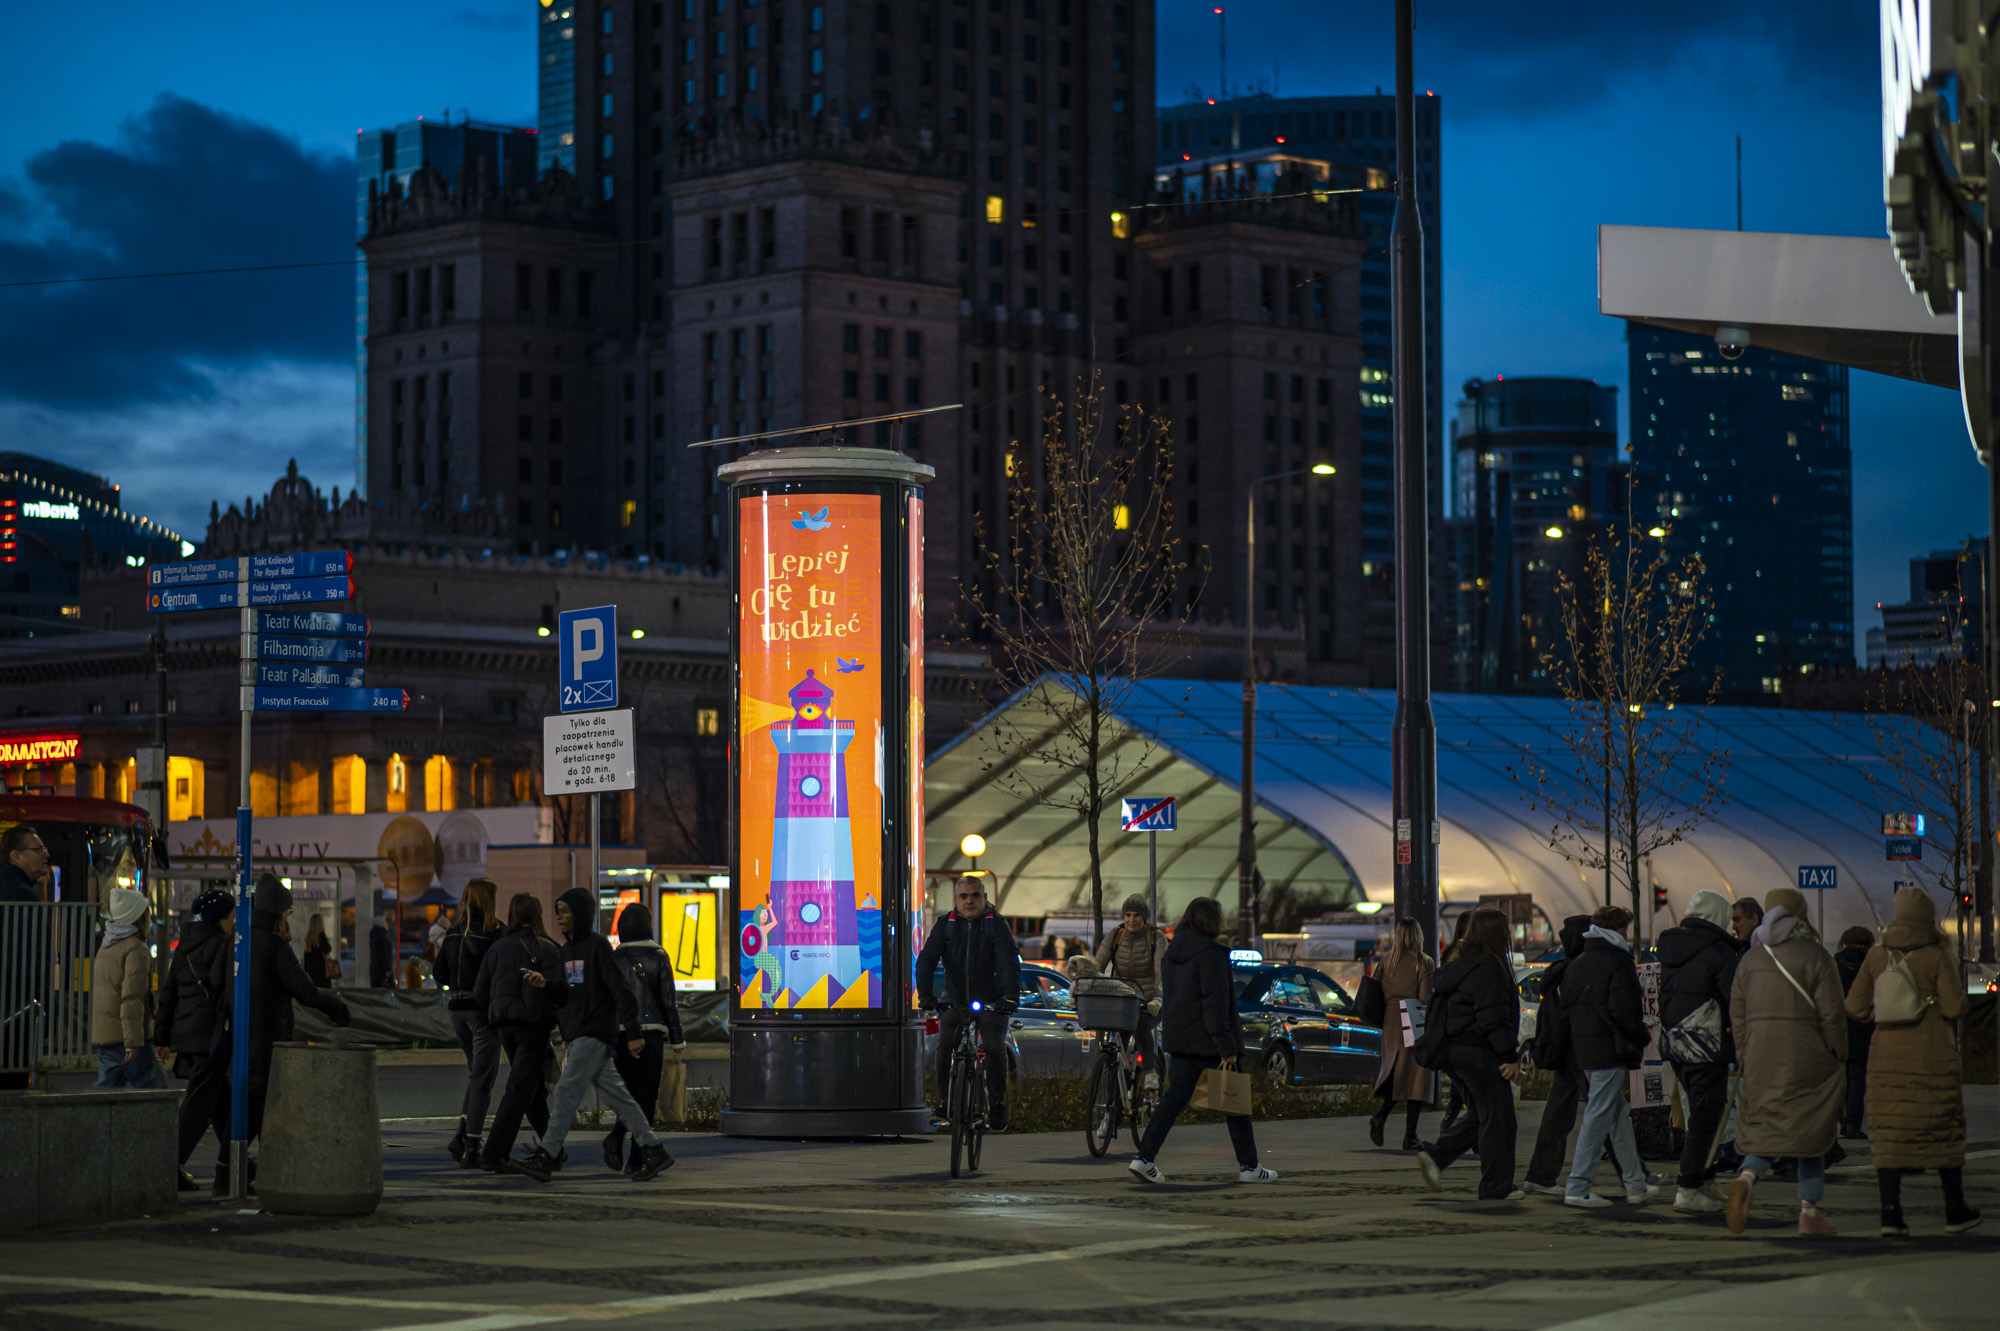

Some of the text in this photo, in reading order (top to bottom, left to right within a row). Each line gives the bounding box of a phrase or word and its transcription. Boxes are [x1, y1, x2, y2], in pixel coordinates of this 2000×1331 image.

[22, 500, 80, 520] mBank
[254, 555, 294, 566] Trakt Królewski
[768, 544, 849, 580] Lepiej
[163, 563, 216, 577] Informacja Turystyczna
[254, 566, 295, 578] The Royal Road
[326, 563, 337, 572] 650
[164, 573, 208, 583] Tourist Information
[218, 570, 229, 579] 670
[253, 582, 291, 594] Polska Agencja
[326, 589, 345, 598] 350 m
[162, 592, 197, 607] Centrum
[220, 594, 227, 603] 80
[253, 592, 278, 604] Inwestycji
[282, 591, 301, 601] Handlu
[751, 583, 836, 615] Cię tu
[265, 613, 337, 631] Teatr Kwadrat
[346, 622, 357, 632] 700
[760, 610, 861, 642] widzieć
[264, 640, 324, 657] Filharmonia
[345, 649, 356, 658] 550
[573, 617, 604, 680] P
[261, 667, 339, 684] Teatr Palladium
[262, 696, 330, 708] Instytut Francuski
[373, 697, 389, 706] 240
[564, 686, 582, 705] 2x
[570, 717, 606, 730] Tylko dla
[562, 728, 615, 741] zaopatrzenia
[596, 739, 624, 749] handlu
[562, 753, 616, 764] detalicznego
[568, 765, 611, 776] do 20 min.
[575, 776, 597, 787] godz.
[599, 773, 616, 783] 6-18
[1127, 803, 1172, 825] TAXI
[1800, 869, 1834, 886] TAXI
